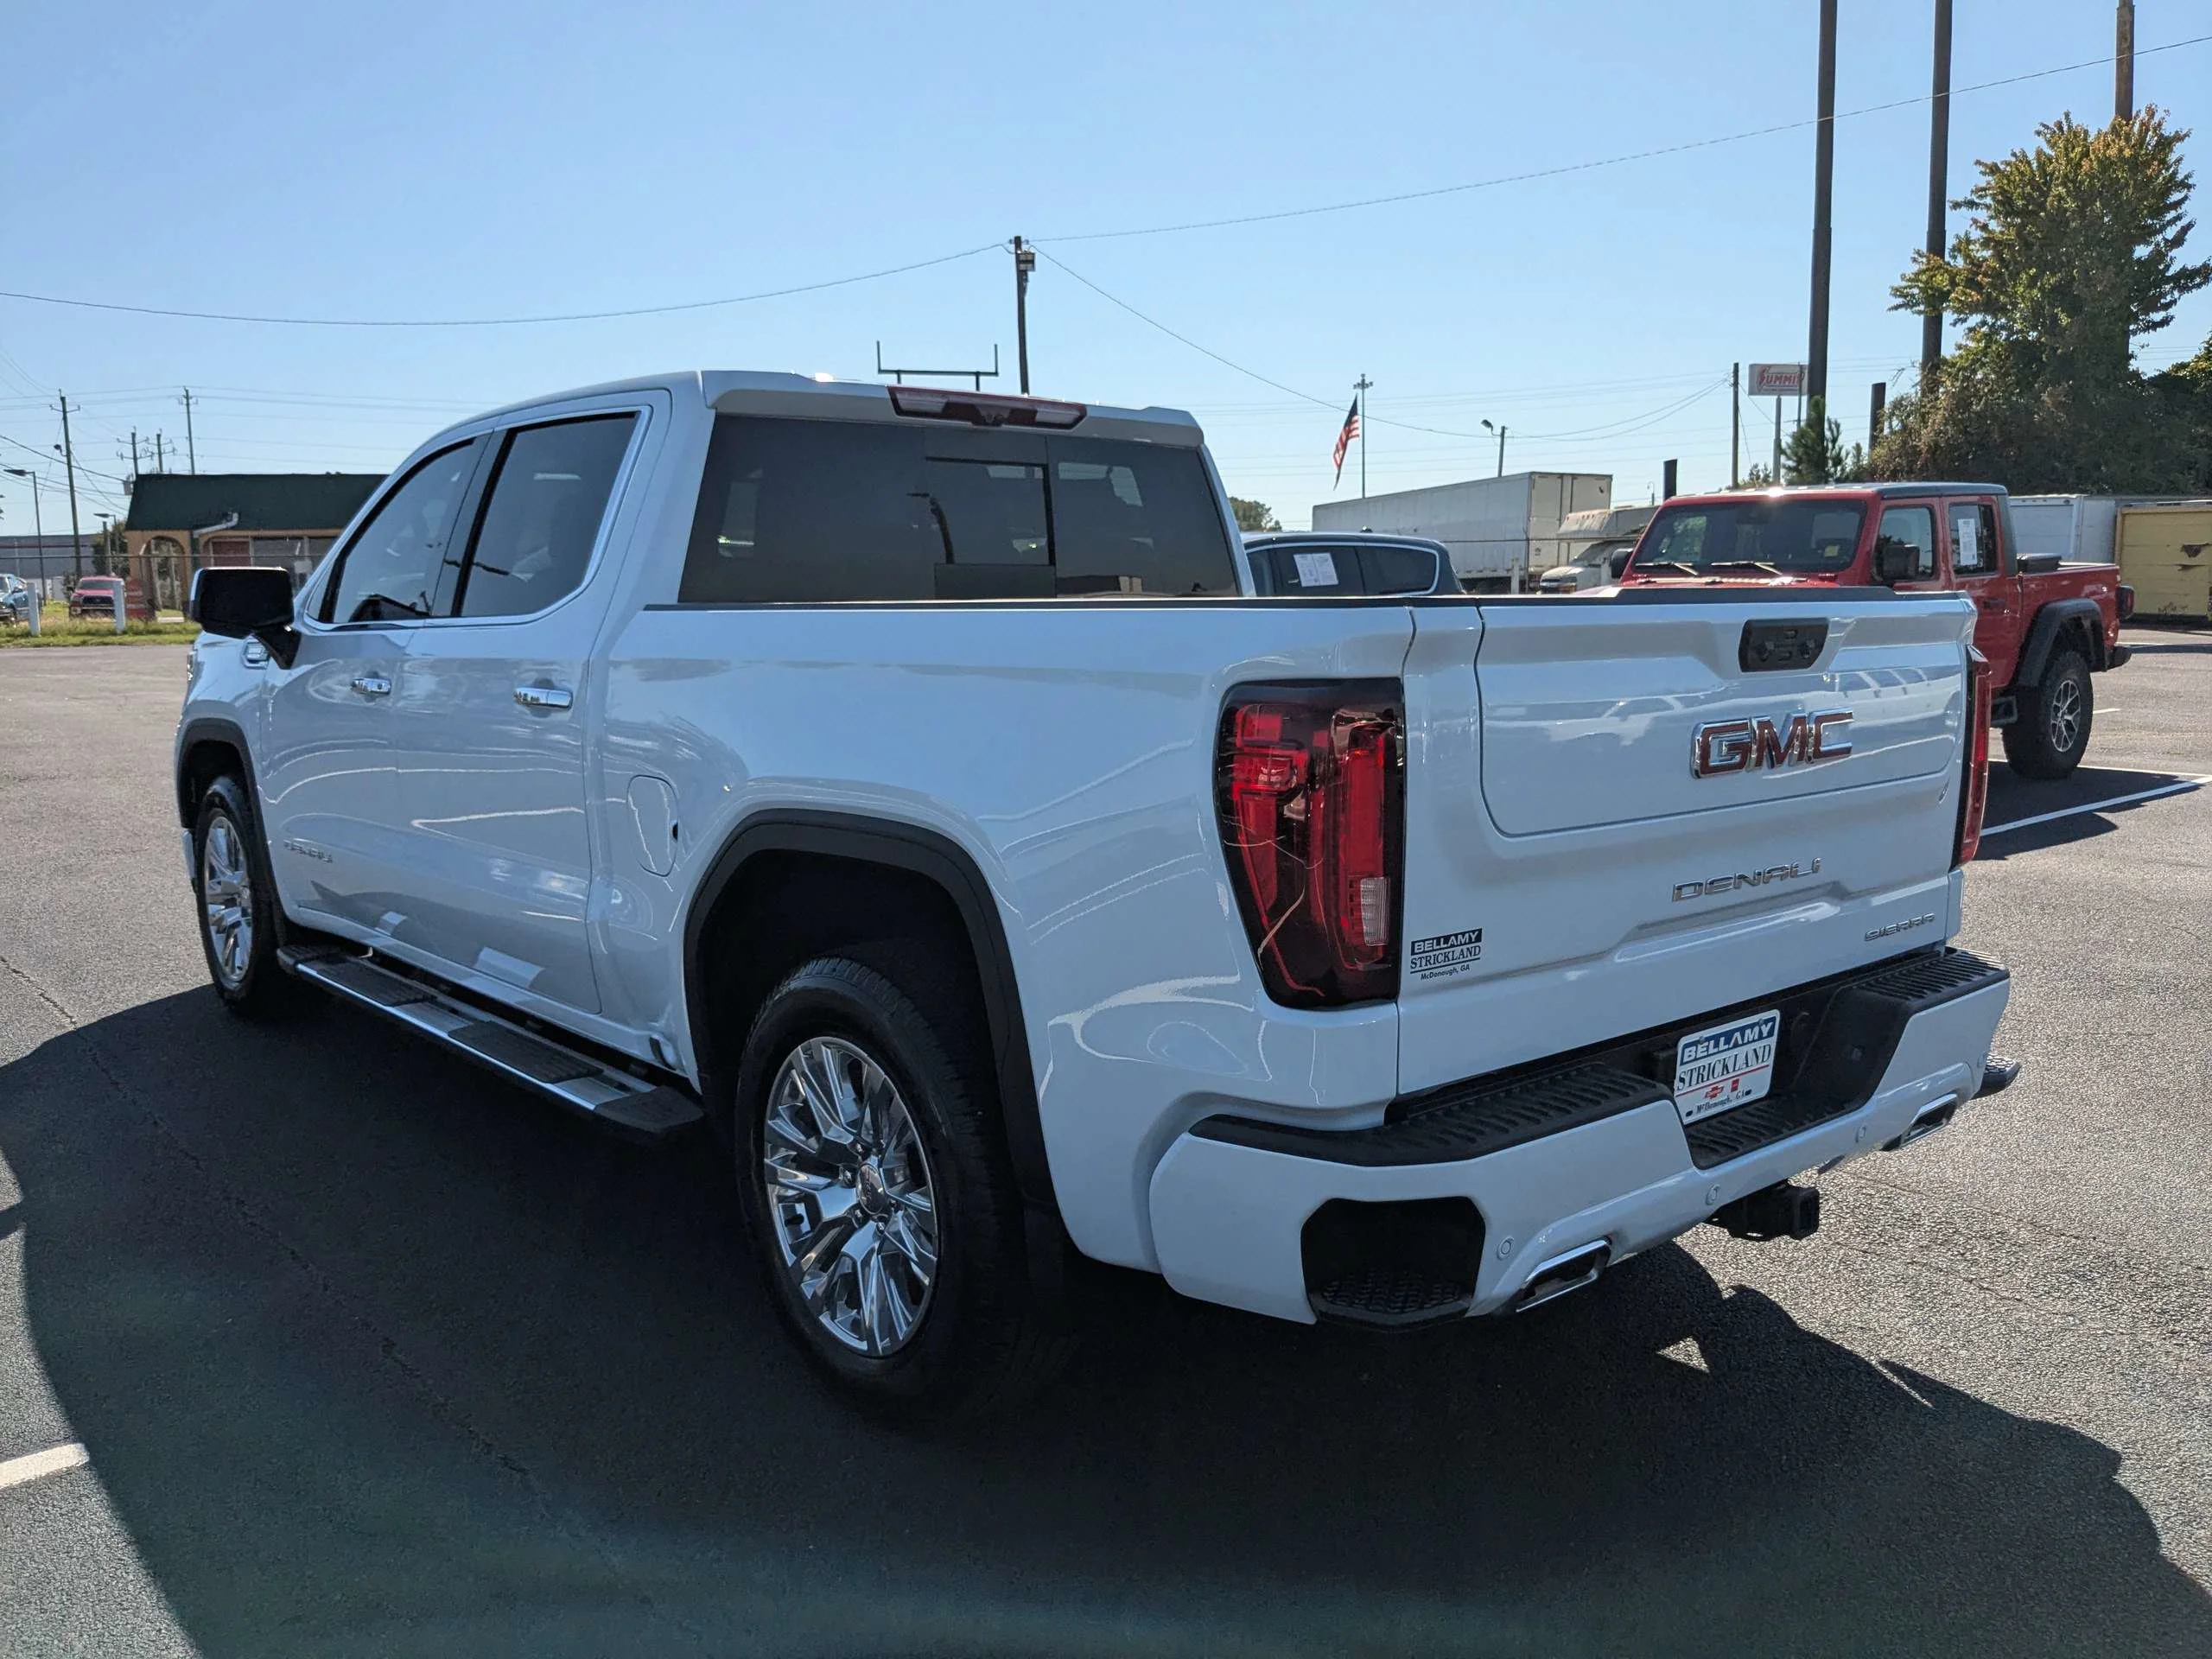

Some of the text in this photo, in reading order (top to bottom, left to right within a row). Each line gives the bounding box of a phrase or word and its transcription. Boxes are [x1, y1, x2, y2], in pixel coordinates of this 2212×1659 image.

[1691, 707, 1854, 778] GMC
[1671, 857, 1821, 902] DENALI
[1414, 931, 1478, 952] BELLAMY
[1865, 912, 1936, 942] SIERRA
[1410, 945, 1481, 969] STRICKLAND
[1683, 1022, 1773, 1063] BELLAMY
[1677, 1044, 1771, 1091] STRICKLAND
